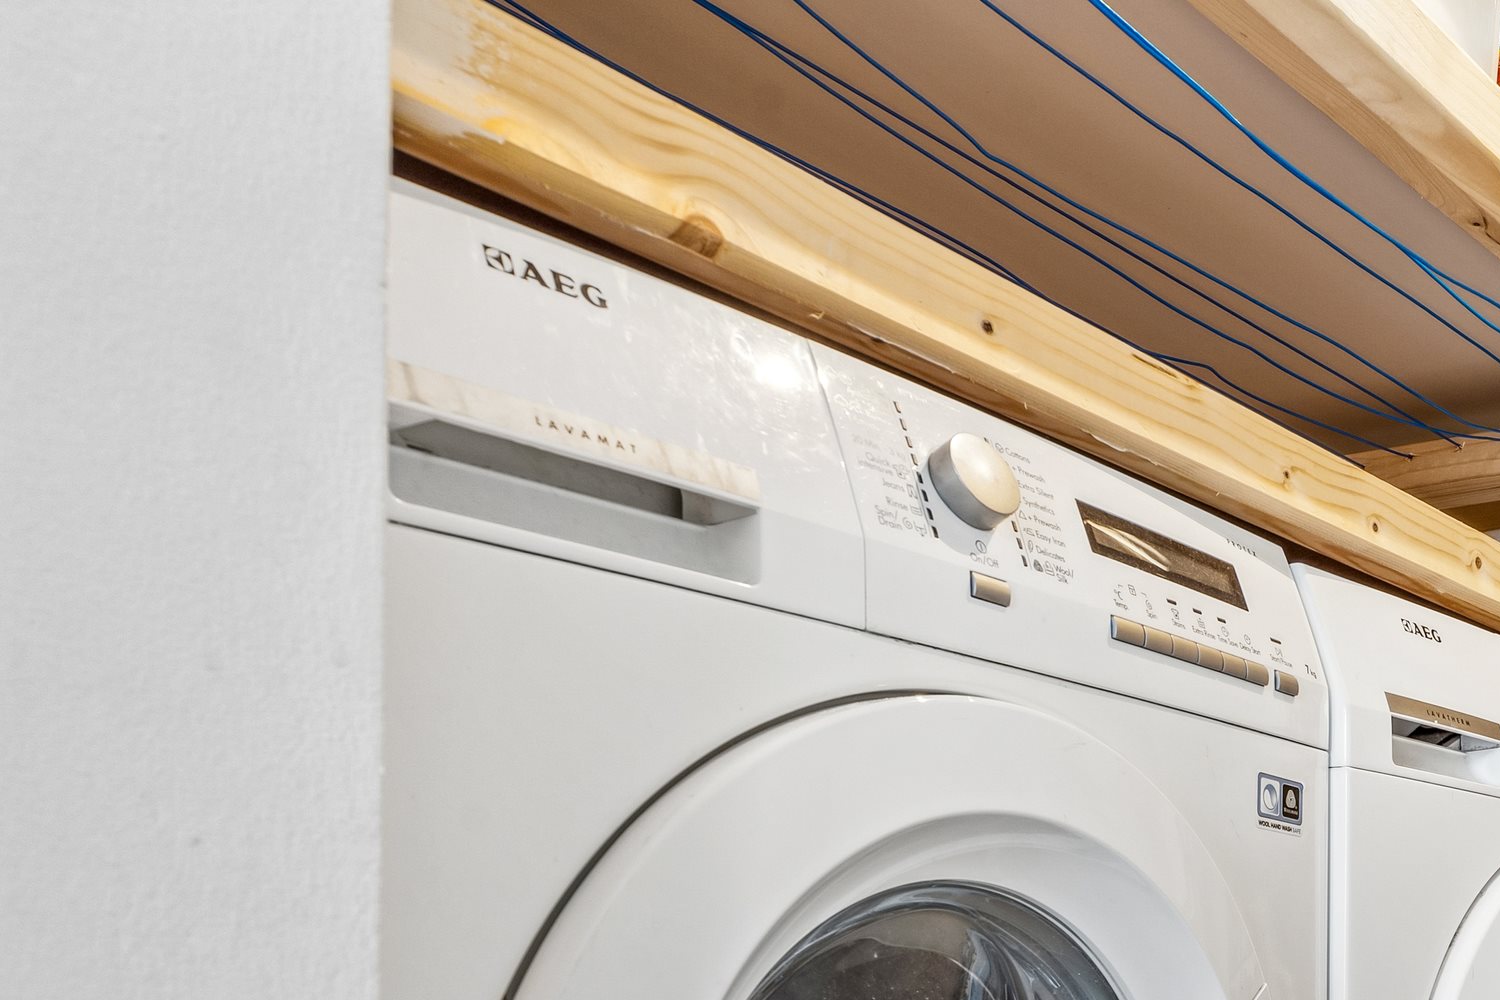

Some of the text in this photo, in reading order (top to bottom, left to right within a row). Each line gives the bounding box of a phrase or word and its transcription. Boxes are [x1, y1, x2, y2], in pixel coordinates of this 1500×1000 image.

[520, 259, 609, 308] AEG
[535, 415, 638, 454] LAVAMAT
[1413, 625, 1441, 643] AEG
[1426, 709, 1471, 727] LAVATHERM
